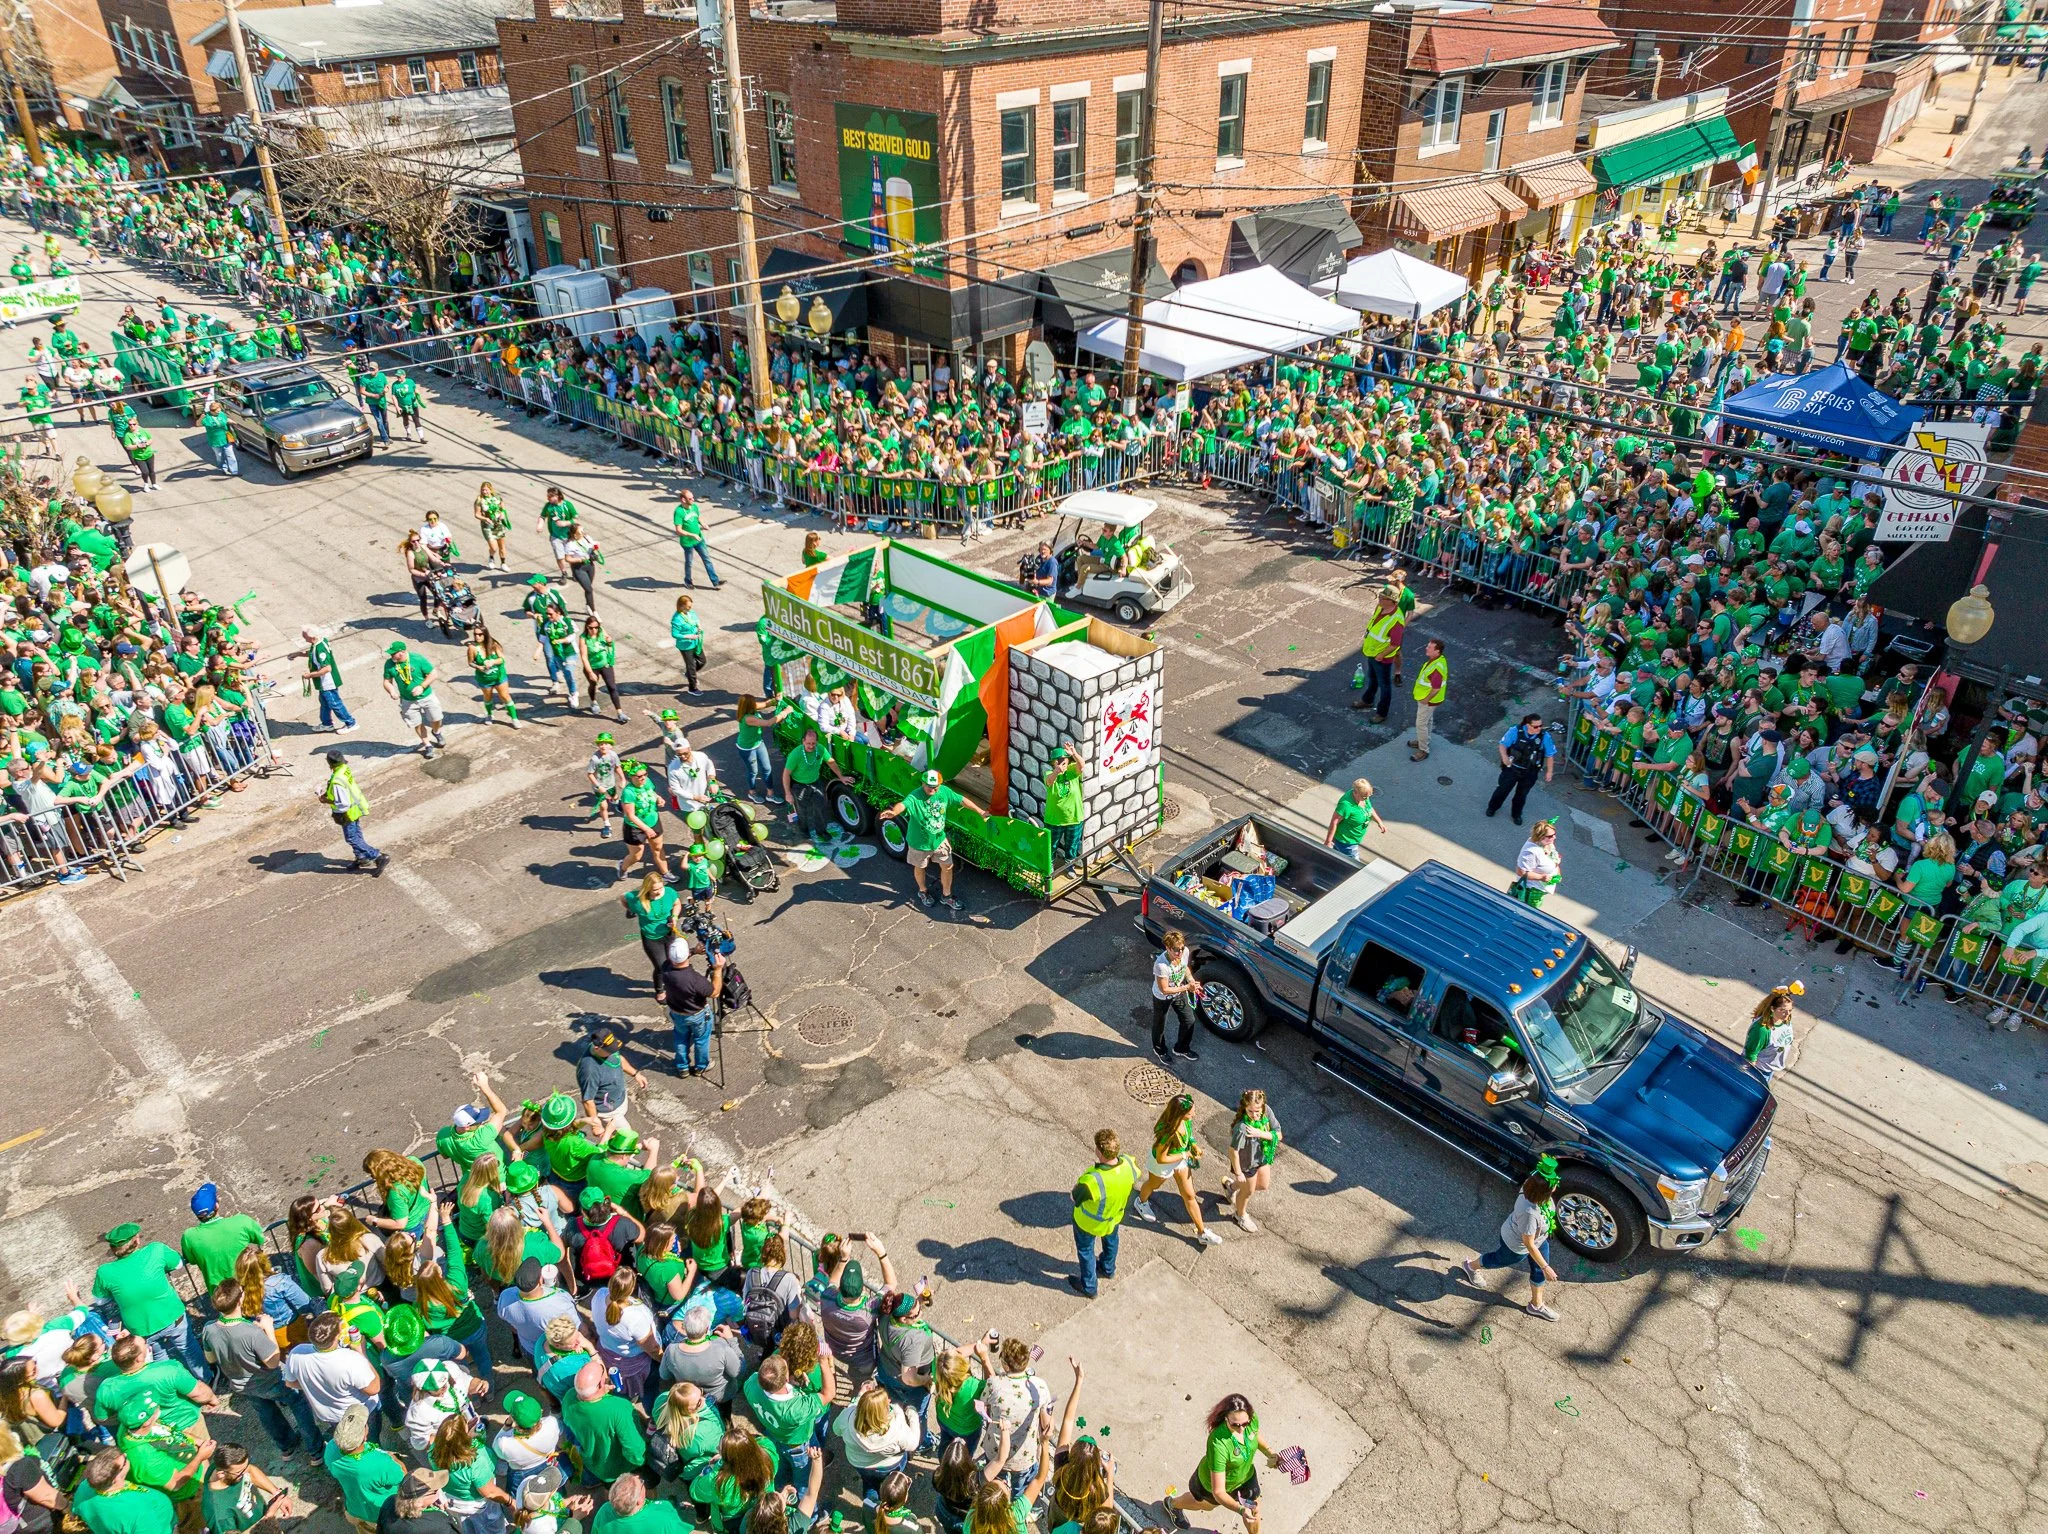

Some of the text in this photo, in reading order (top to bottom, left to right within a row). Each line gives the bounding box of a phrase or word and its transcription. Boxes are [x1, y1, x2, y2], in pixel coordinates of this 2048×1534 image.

[843, 128, 931, 161] BEST SERVED GOLD
[1452, 219, 1468, 232] VIOLA
[1468, 216, 1485, 228] CELLO
[1803, 401, 1827, 416] SIX
[1811, 390, 1856, 412] SERIES
[1892, 463, 1981, 482] ACME
[1886, 512, 1951, 522] GUITARS
[764, 592, 935, 692] Walsh Clan est 1867
[773, 622, 930, 703] HAPPY ST. PATRICK'S DAY
[1699, 827, 1716, 839] GUINNESS
[1728, 827, 1737, 850] GUINNESS
[1749, 835, 1760, 858] GUINNESS
[1768, 860, 1786, 872] GUINNESS
[1800, 859, 1810, 883] GUINNESS
[1823, 868, 1834, 892] GUINNESS
[1843, 890, 1863, 900] GUINNESS
[1866, 888, 1882, 909] GUINNESS
[1154, 895, 1185, 920] FX4
[1887, 903, 1905, 924] GUINNESS
[1911, 928, 1931, 942] GUINNESS
[1949, 930, 1961, 954] GUINNESS
[1975, 940, 1989, 964] GUINNESS
[2003, 962, 2027, 972] GUINNESS
[1144, 1068, 1163, 1097] WATER
